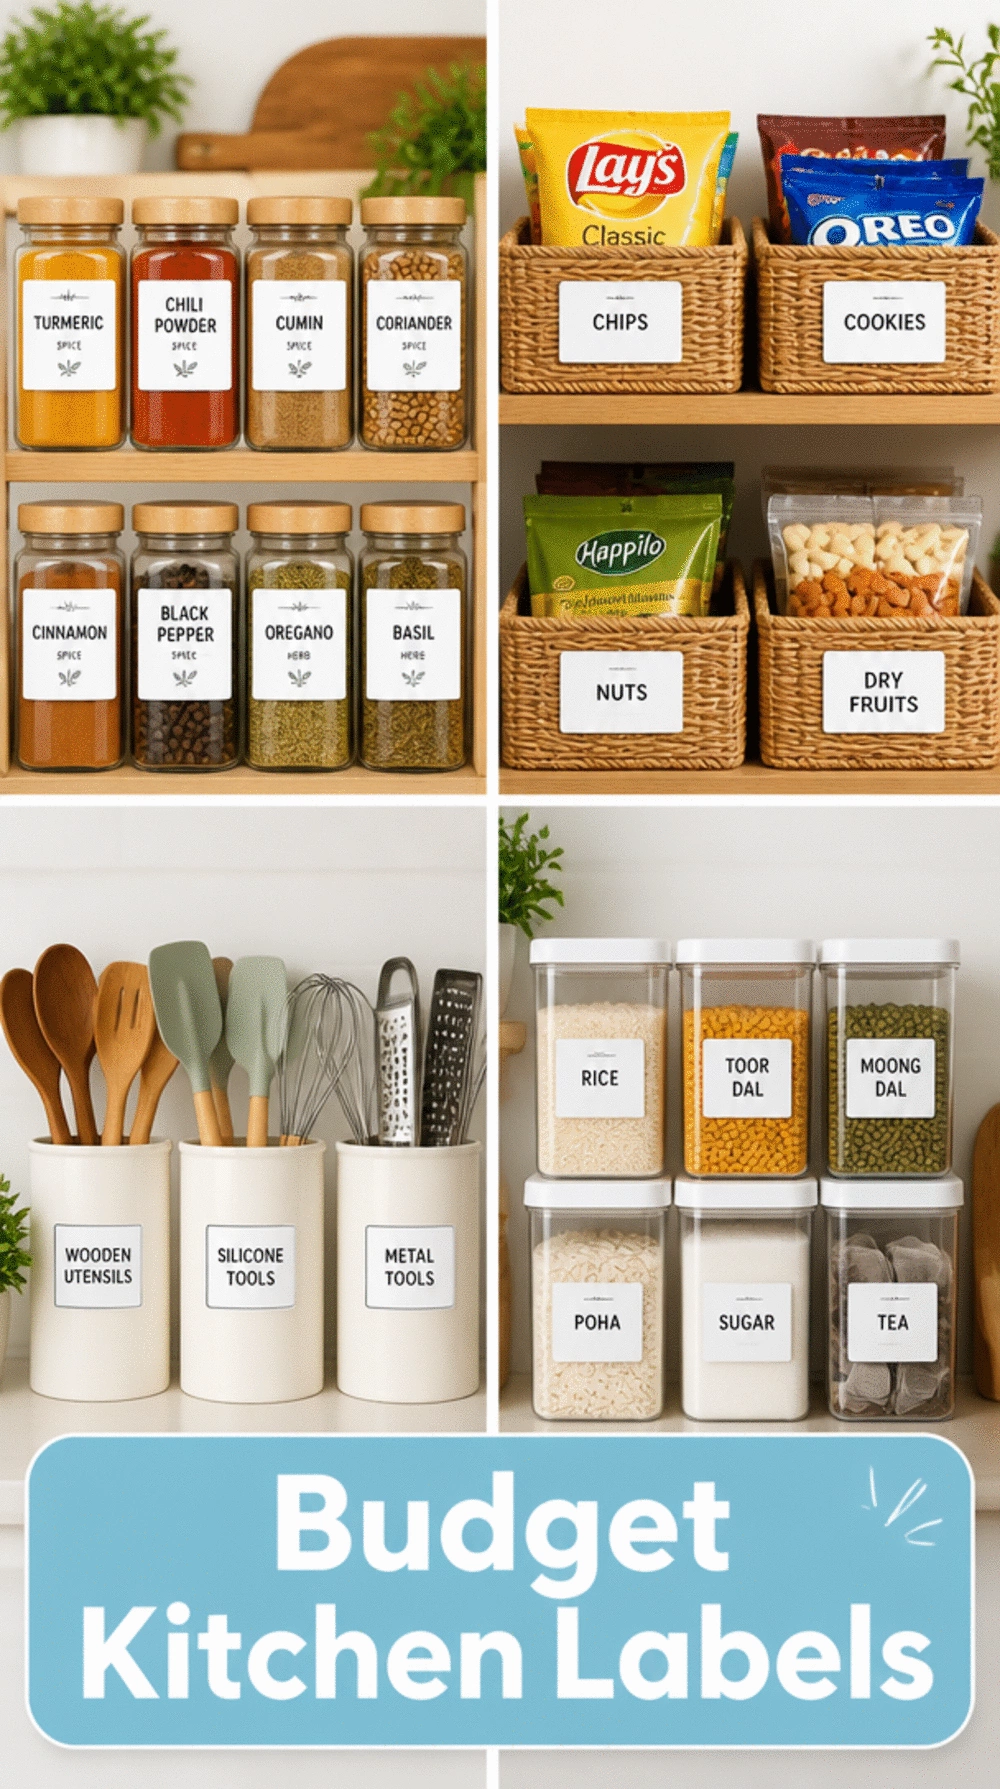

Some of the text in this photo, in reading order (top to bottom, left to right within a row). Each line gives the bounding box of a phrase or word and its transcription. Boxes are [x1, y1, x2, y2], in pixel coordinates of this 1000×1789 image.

[575, 145, 678, 196] Lay's
[582, 225, 666, 246] Classic
[813, 214, 955, 246] OREO
[166, 297, 202, 312] CHILI
[34, 316, 103, 330] TURMERIC
[155, 318, 216, 333] POWDER
[276, 316, 323, 330] CUMIN
[377, 316, 451, 330] CORIANDER
[593, 314, 648, 330] CHIPS
[844, 314, 925, 331] COOKIES
[580, 532, 663, 569] Happilo
[161, 606, 208, 621] BLACK
[33, 625, 107, 640] CINNAMON
[158, 627, 214, 642] PEPPER
[265, 625, 333, 640] OREGANO
[393, 625, 434, 640] BASIL
[865, 672, 903, 689] DRY
[597, 684, 647, 701] NUTS
[850, 696, 918, 712] FRUITS
[726, 1057, 769, 1074] TOOR
[861, 1058, 921, 1074] MOONG
[582, 1070, 618, 1086] RICE
[733, 1081, 763, 1097] DAL
[876, 1081, 906, 1097] DAL
[66, 1248, 130, 1262] WOODEN
[218, 1248, 283, 1263] SILICONE
[386, 1248, 434, 1263] METAL
[65, 1269, 132, 1284] UTENSILS
[227, 1271, 275, 1286] TOOLS
[385, 1271, 434, 1286] TOOLS
[575, 1315, 620, 1330] POHA
[720, 1315, 774, 1330] SUGAR
[878, 1314, 908, 1330] TEA
